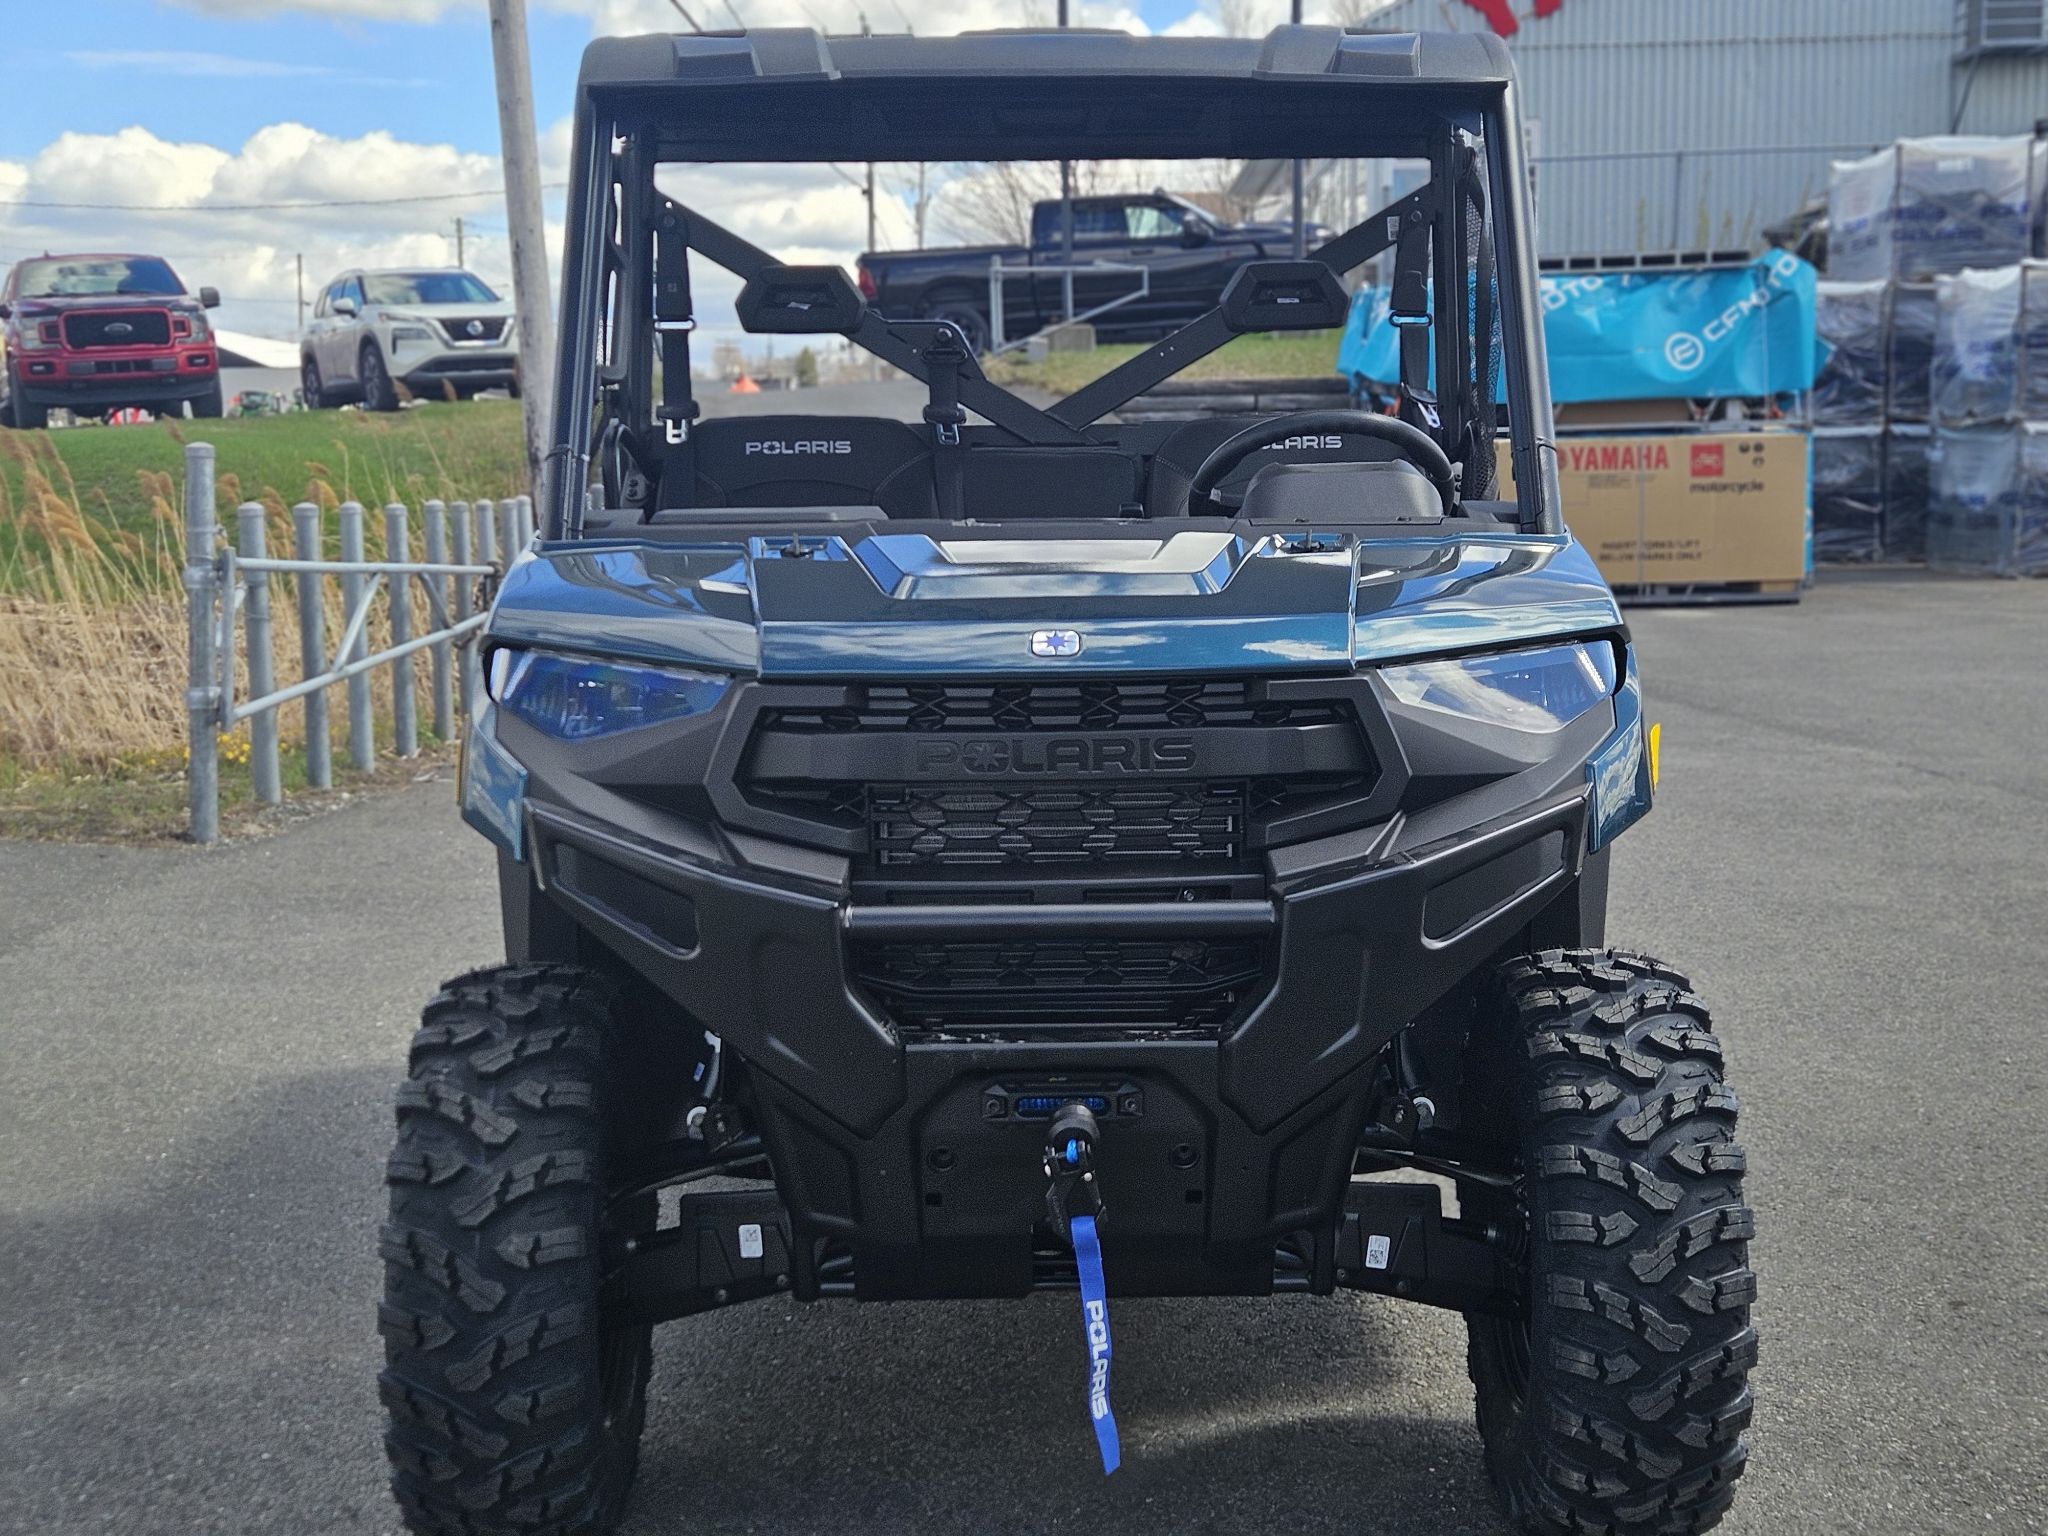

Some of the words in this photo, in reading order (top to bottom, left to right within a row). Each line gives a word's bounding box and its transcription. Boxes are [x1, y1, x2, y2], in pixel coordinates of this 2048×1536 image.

[745, 440, 852, 455] POLARIS
[1569, 444, 1670, 472] YAMAHA
[1689, 480, 1765, 494] motorcycle
[914, 737, 1199, 775] POLARIS
[1085, 1299, 1109, 1420] POLARIS
